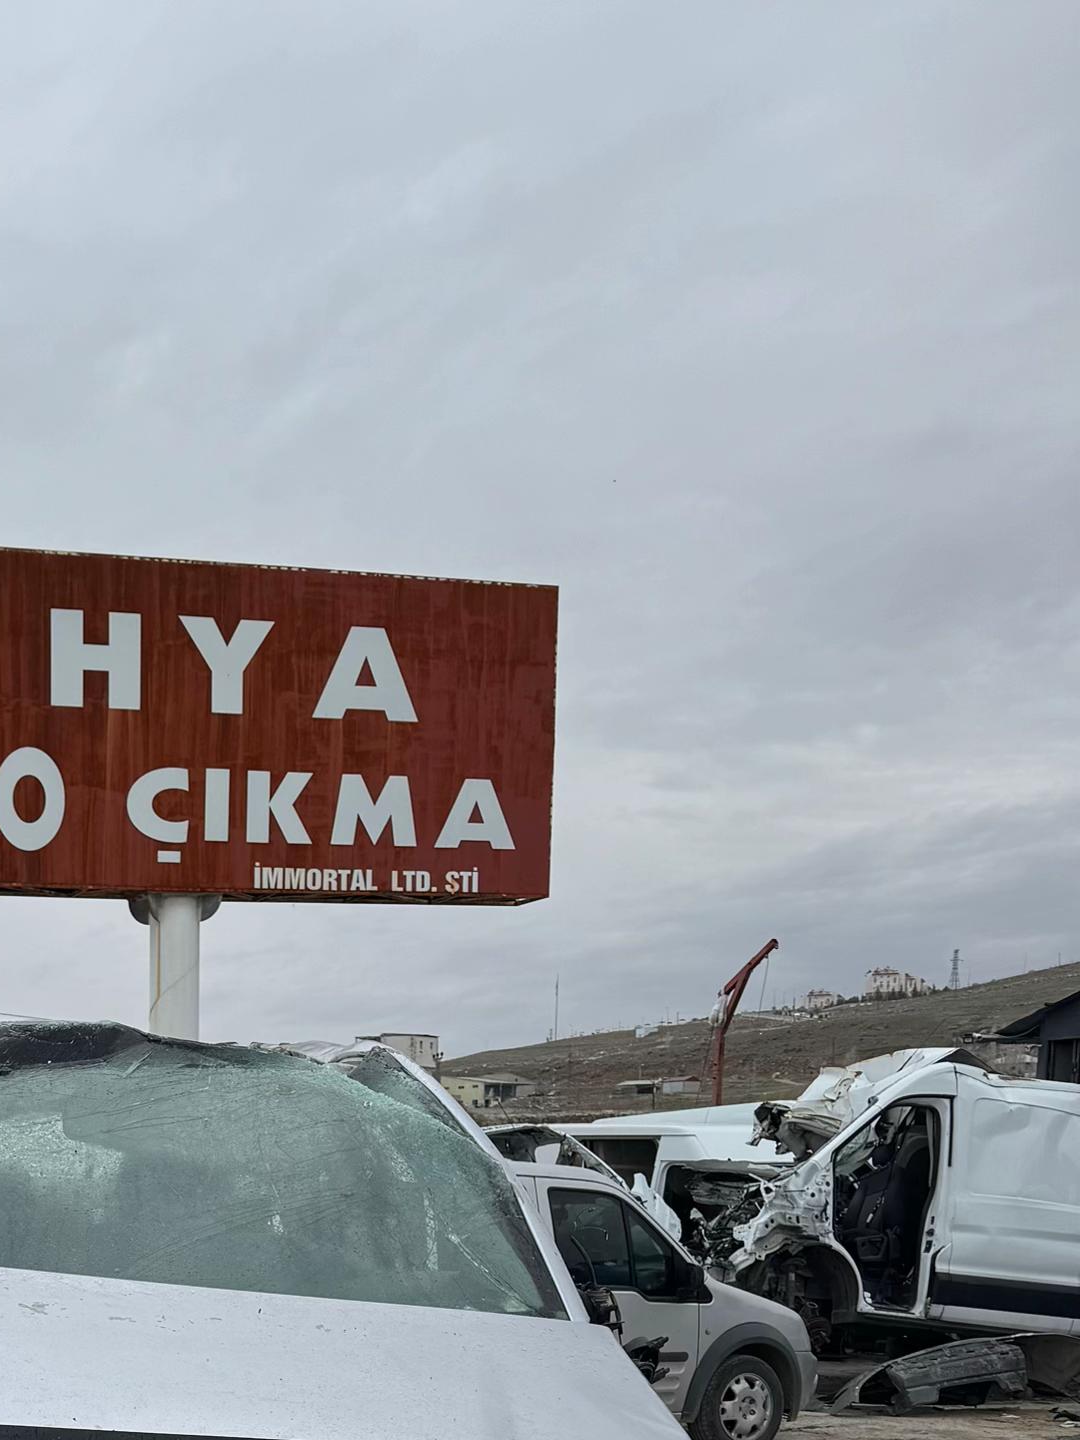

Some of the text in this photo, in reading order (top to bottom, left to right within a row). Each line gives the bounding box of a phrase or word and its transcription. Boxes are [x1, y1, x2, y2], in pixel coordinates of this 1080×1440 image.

[125, 766, 517, 865] ÇIKMA
[253, 861, 480, 895] İMMORTAL LTD. ŞTİ
